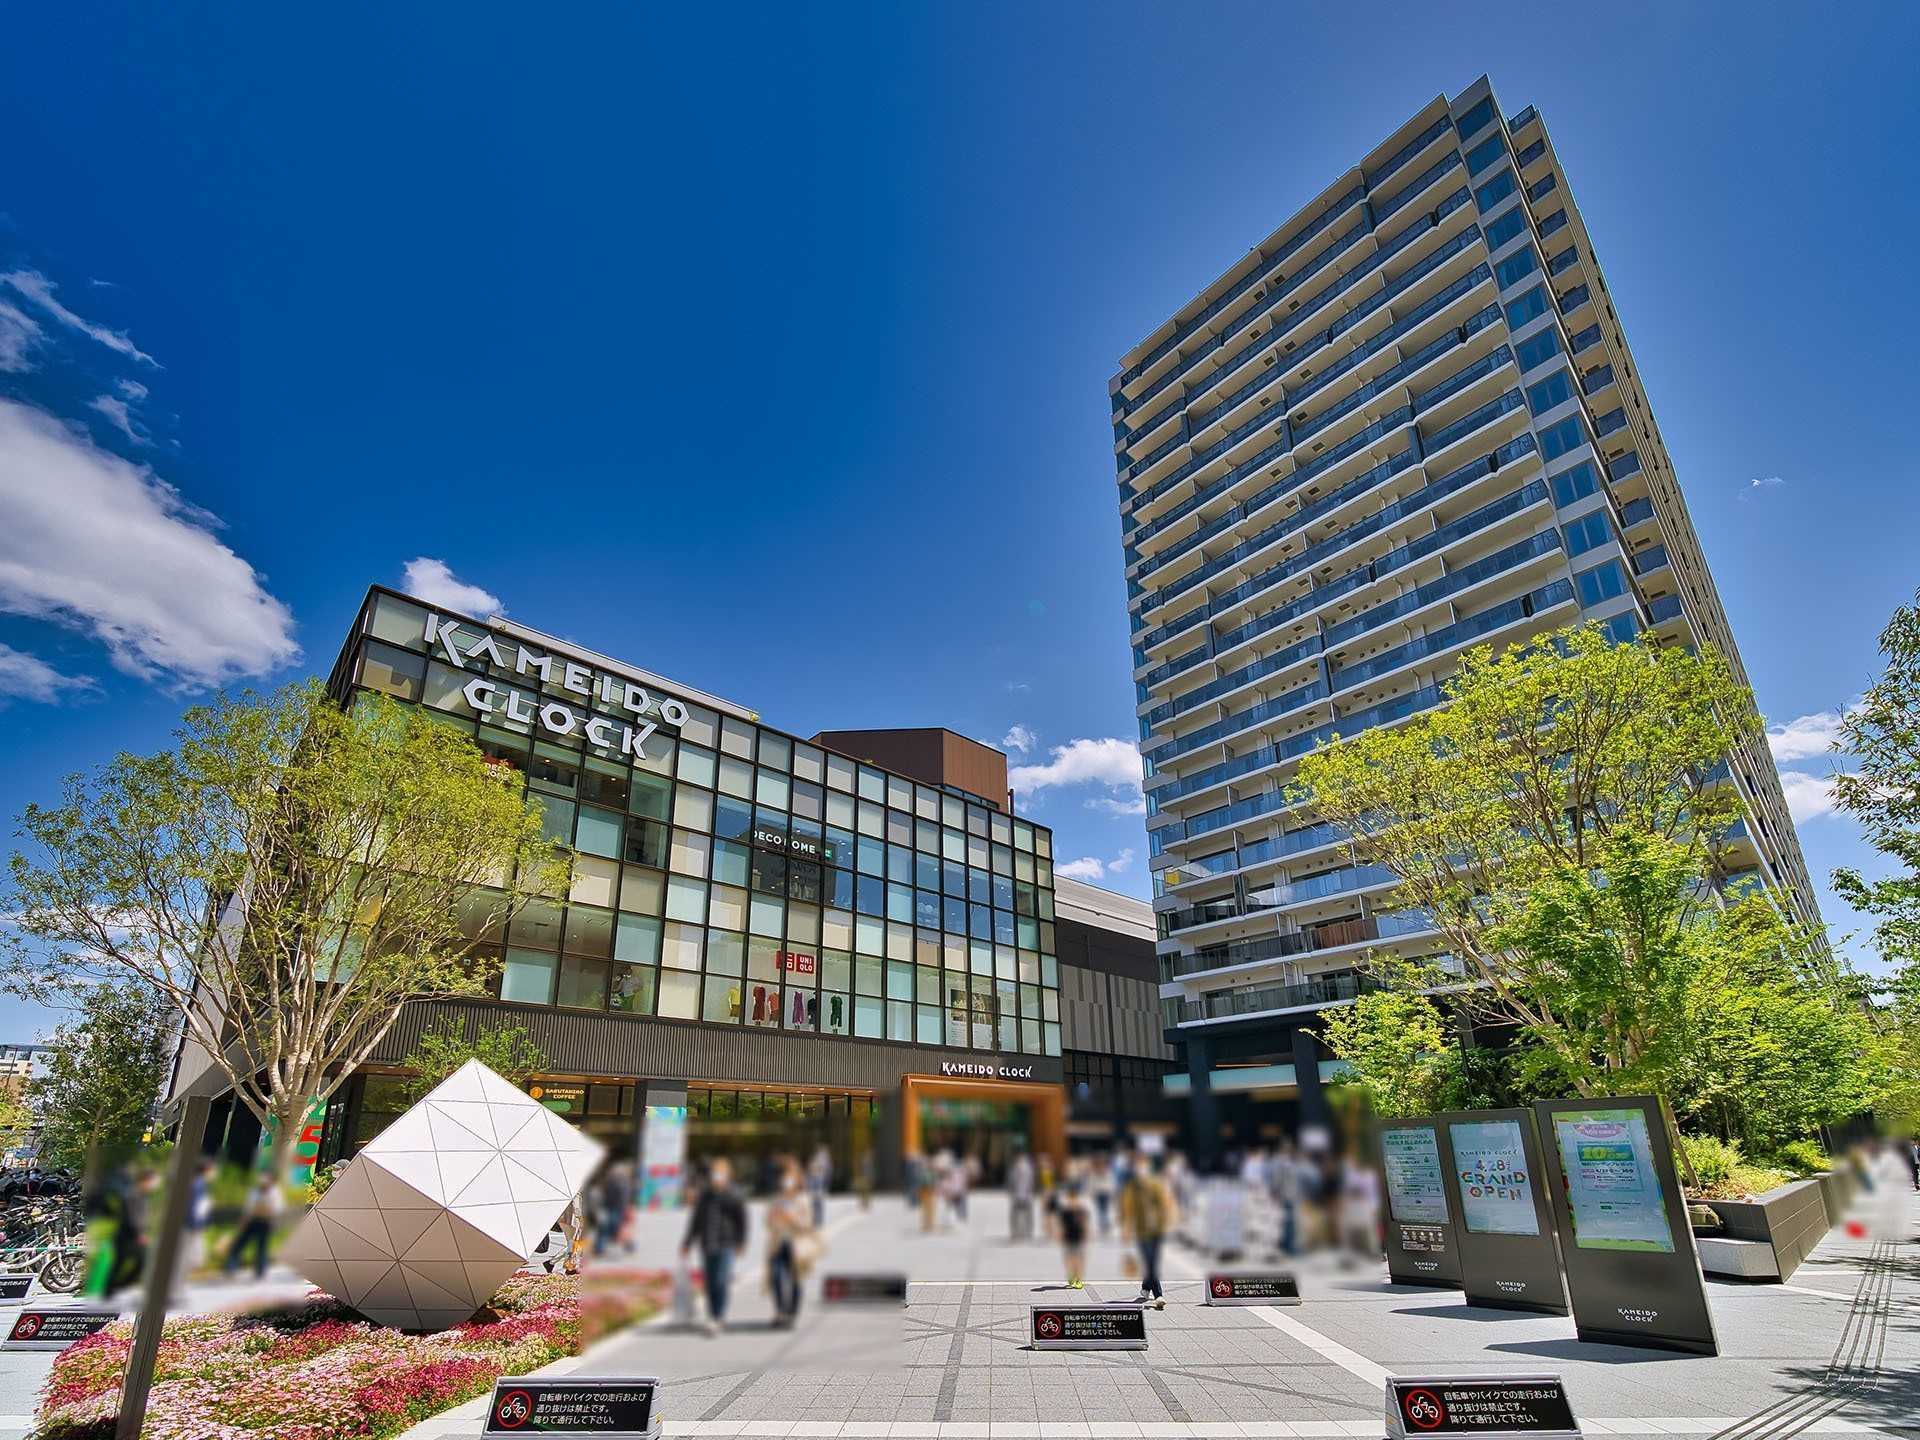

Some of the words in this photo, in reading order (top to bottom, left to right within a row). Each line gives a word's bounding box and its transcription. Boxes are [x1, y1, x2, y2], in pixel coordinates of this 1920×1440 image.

[424, 612, 690, 728] KAMEIDO
[462, 678, 658, 760] CLOCK
[800, 956, 812, 965] UNI
[800, 963, 813, 972] QLO
[942, 1062, 994, 1076] KAMEIDO
[999, 1066, 1032, 1078] CLOCK
[1475, 1159, 1506, 1172] 4.28
[1461, 1171, 1526, 1185] GRAND
[1470, 1185, 1522, 1200] OPEN
[1617, 1308, 1658, 1316] KAMEIDO
[538, 1392, 646, 1402] 自転車やバイクでの走行および
[1444, 1390, 1558, 1400] 自転車やバイクでの走行および
[536, 1404, 610, 1413] 通り抜けは禁止です。
[1447, 1402, 1527, 1412] 通り抜けは禁止です。
[533, 1415, 615, 1425] 降りて通行して下さい。
[1450, 1414, 1539, 1424] 降りて通行して下さい。
